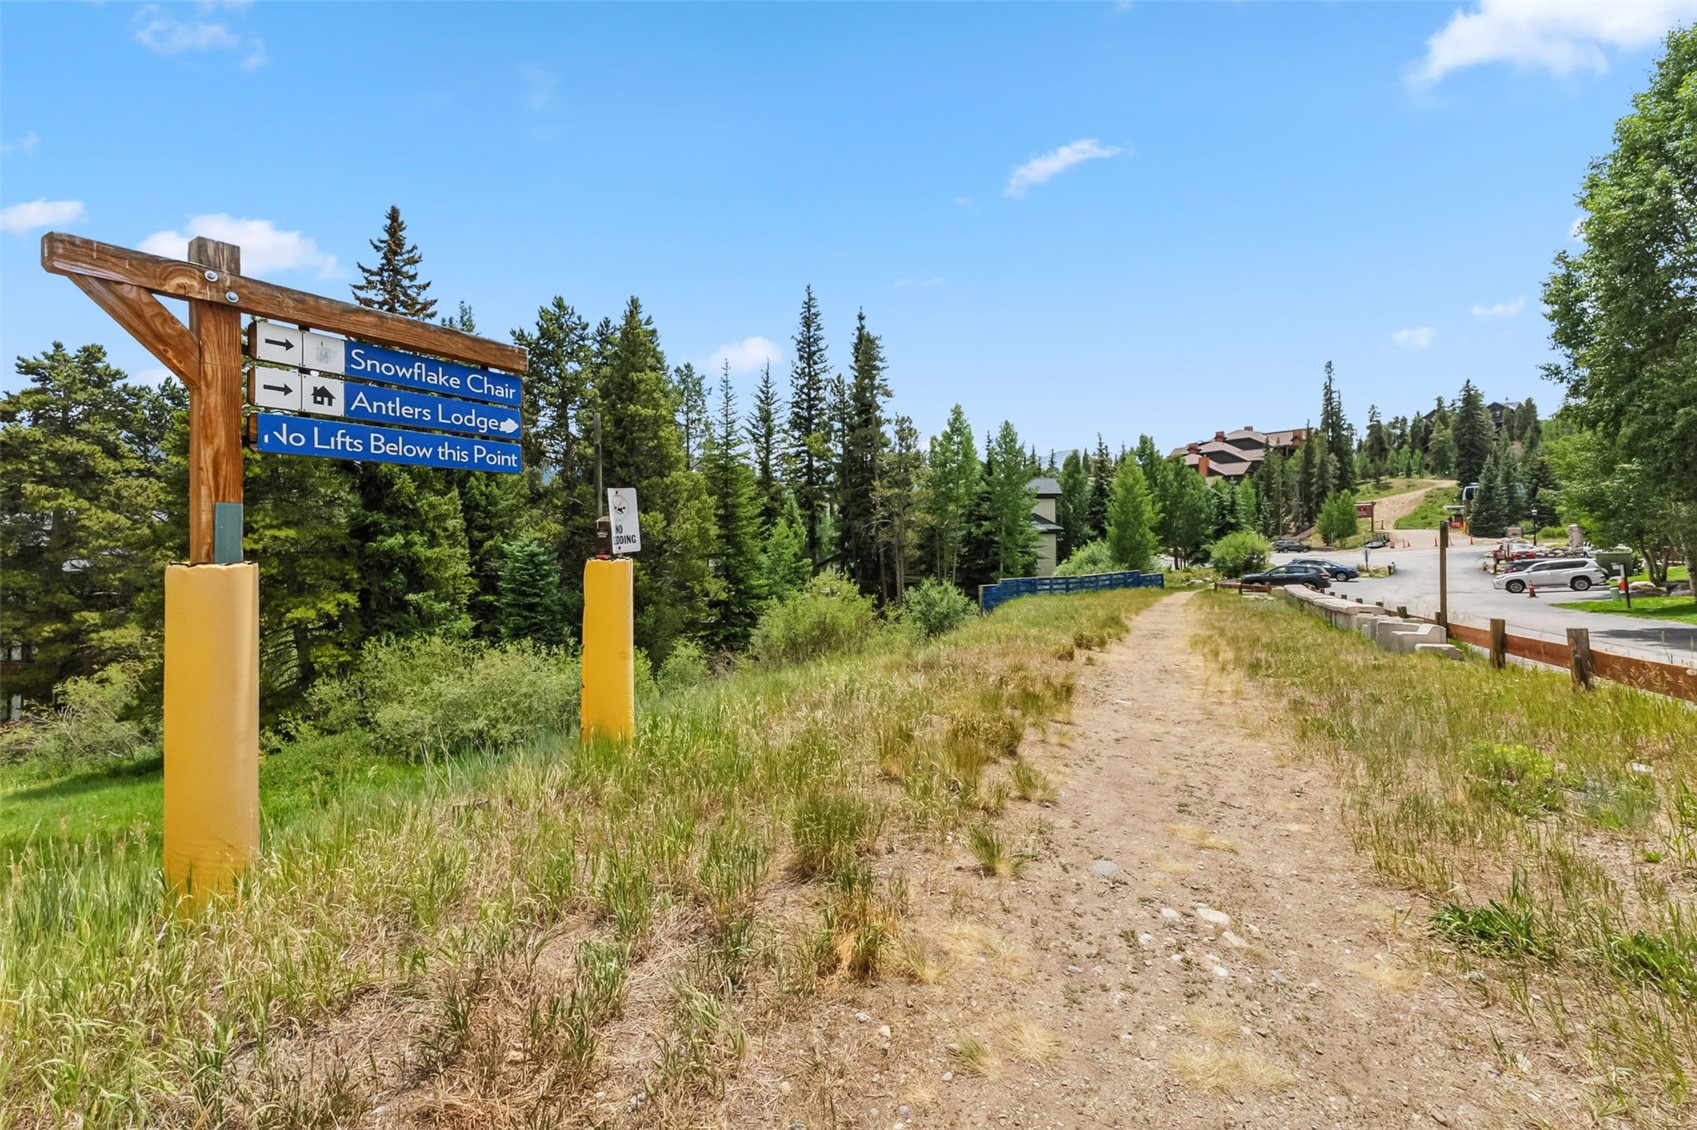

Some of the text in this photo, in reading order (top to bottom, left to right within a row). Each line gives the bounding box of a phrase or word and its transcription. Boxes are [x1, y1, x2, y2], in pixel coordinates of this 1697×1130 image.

[351, 349, 516, 399] Snowflake Chair
[351, 391, 499, 433] Antlers Lodge
[263, 423, 517, 467] No Lifts Below this Point
[615, 525, 624, 534] NO
